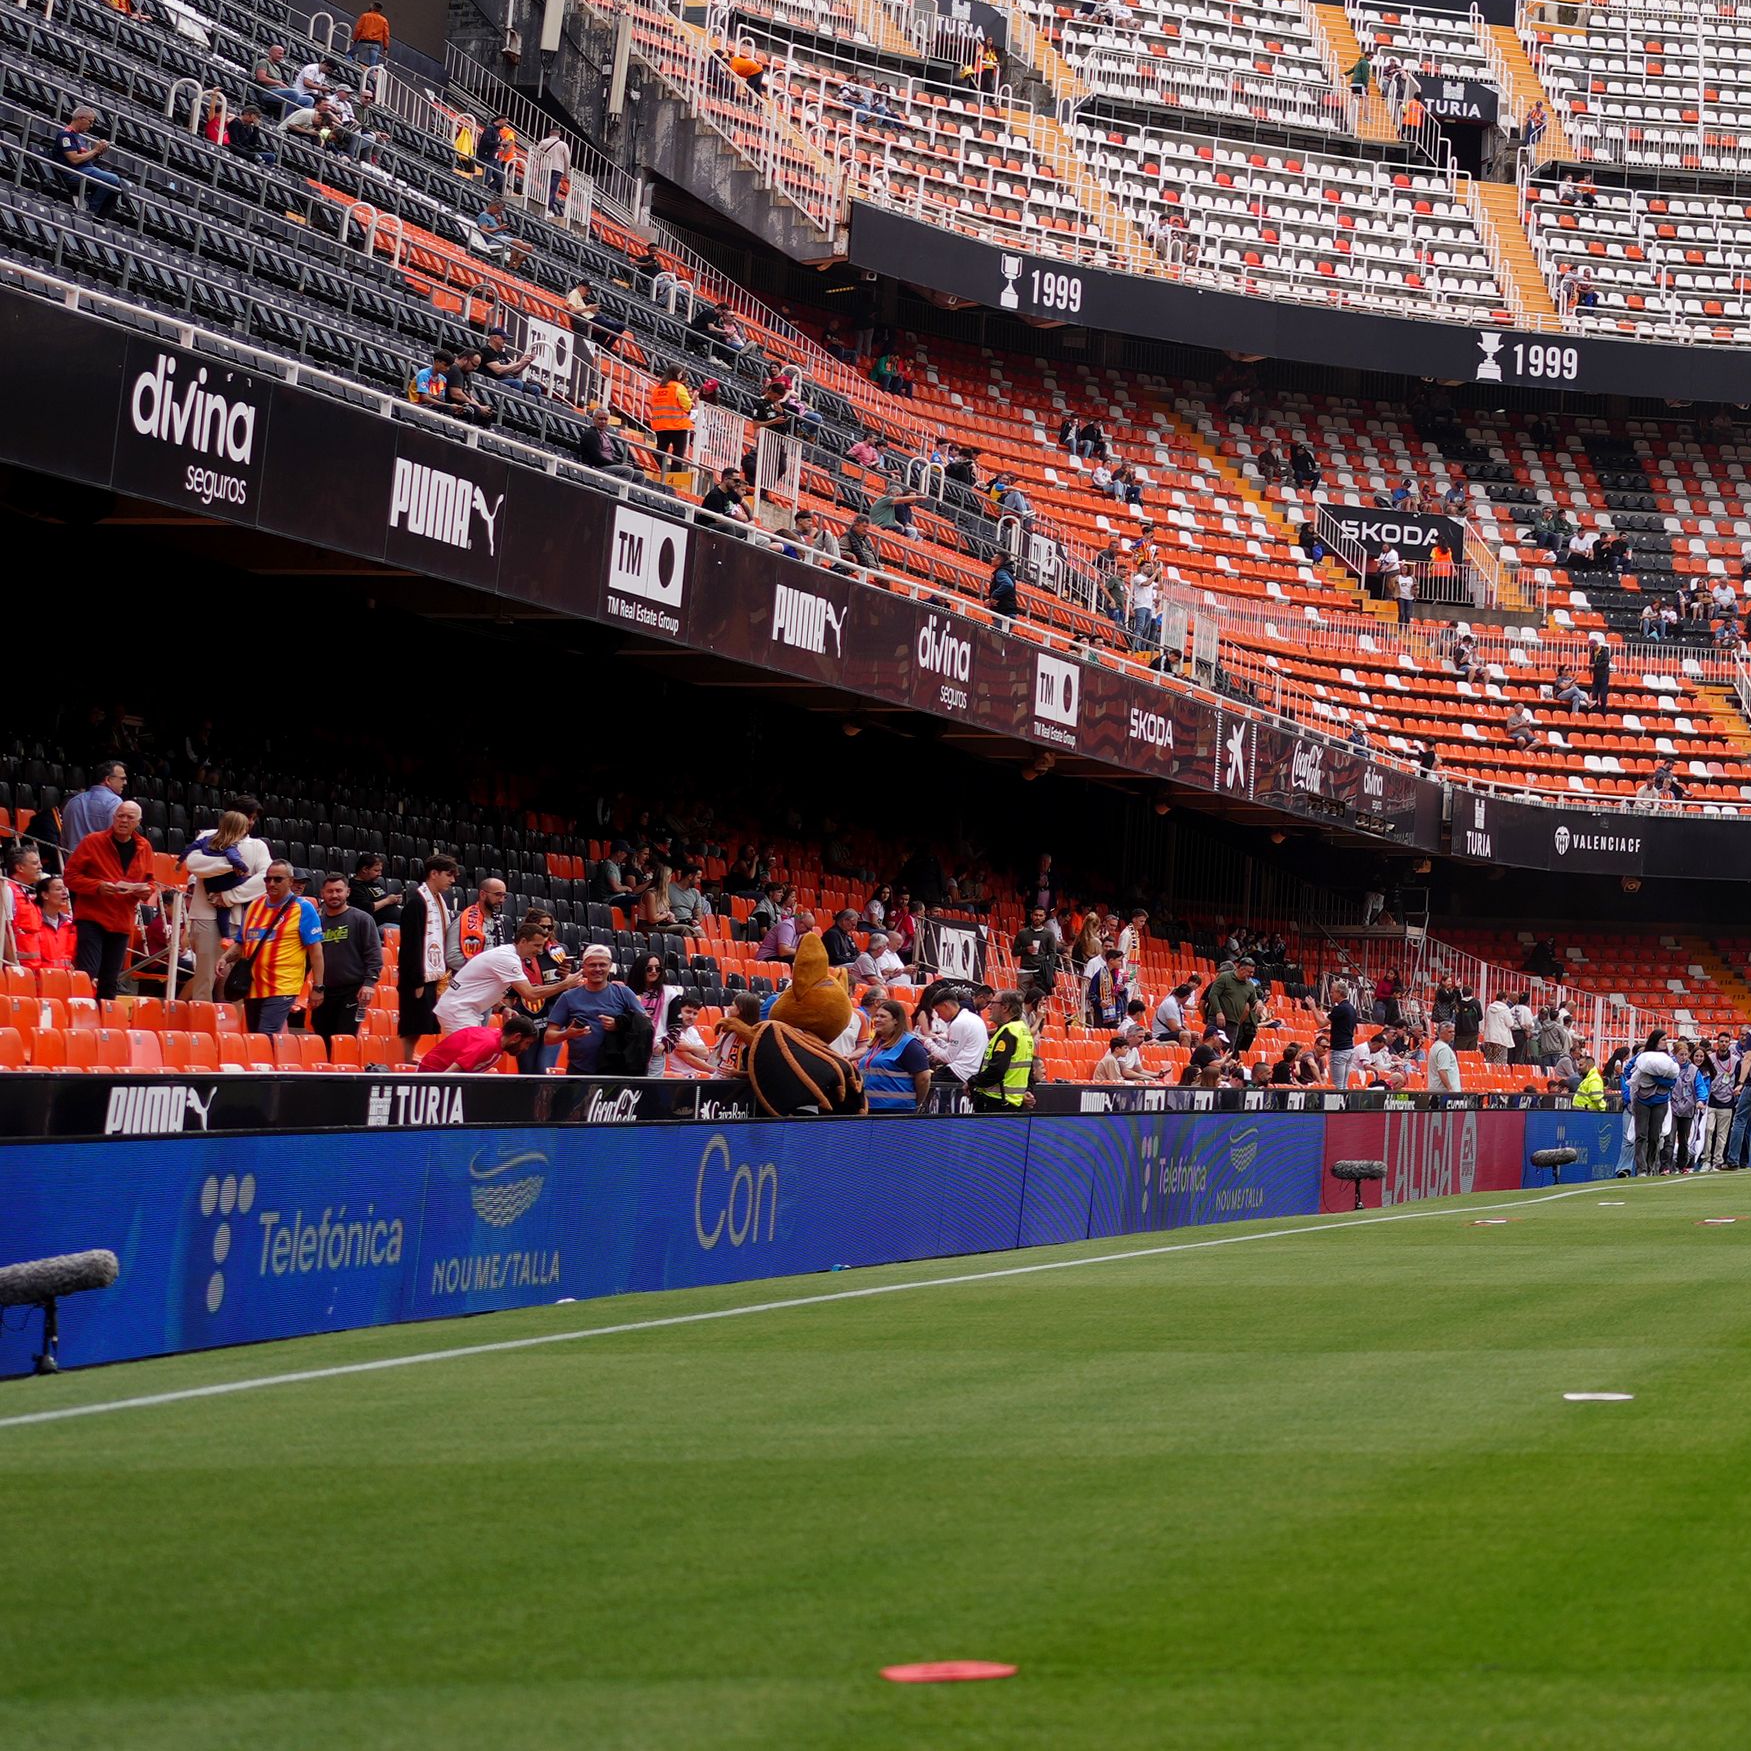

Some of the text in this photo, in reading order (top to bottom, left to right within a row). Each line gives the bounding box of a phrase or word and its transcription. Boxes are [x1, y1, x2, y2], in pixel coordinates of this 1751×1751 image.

[1424, 98, 1481, 118] TURIA
[1031, 269, 1082, 313] 1999
[1513, 343, 1578, 380] 1999
[132, 353, 257, 465] divina
[185, 464, 247, 504] seguros
[389, 456, 473, 550] PUMA
[618, 531, 644, 577] TM
[607, 594, 680, 636] TM Real Estate Group
[771, 582, 828, 655] PUMA
[918, 614, 971, 683] divina
[940, 683, 967, 711] seguros
[1039, 672, 1054, 706] TM
[1033, 721, 1077, 748] TM Real Estate Group
[1129, 707, 1174, 749] SKODA
[1363, 765, 1384, 797] divina
[1466, 830, 1491, 858] TURIA
[104, 1086, 187, 1136] PUMA
[396, 1085, 464, 1126] TURIA
[1159, 1154, 1208, 1195] Telefónica
[1382, 1112, 1453, 1209] LALIGA
[695, 1133, 778, 1250] Con
[259, 1202, 404, 1277] Telefónica
